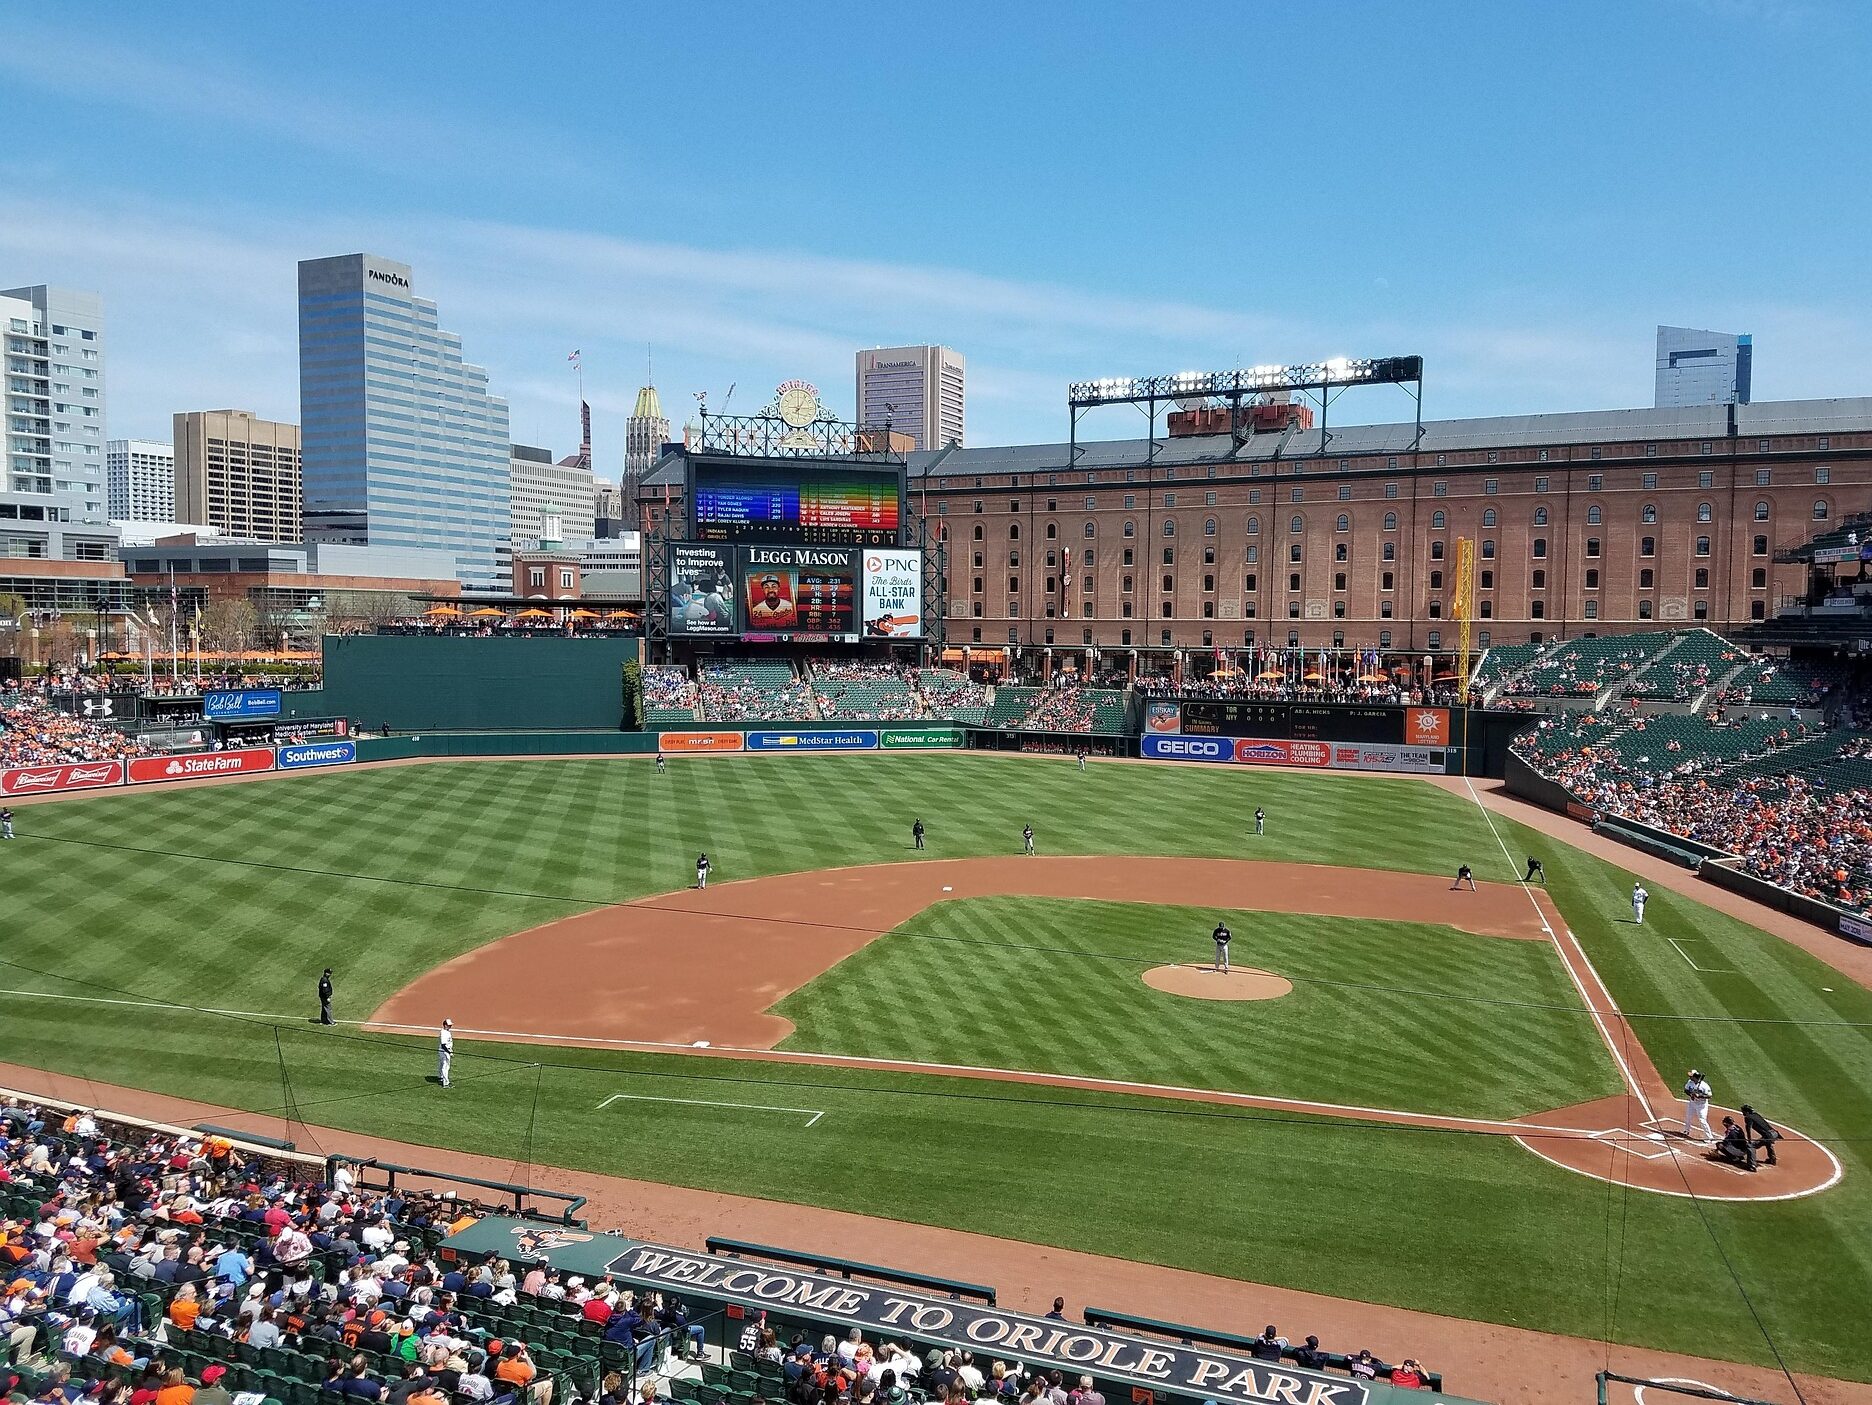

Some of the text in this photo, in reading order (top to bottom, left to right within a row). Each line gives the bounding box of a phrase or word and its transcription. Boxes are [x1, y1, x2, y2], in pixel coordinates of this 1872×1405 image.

[855, 534, 894, 544] 2 0 1
[676, 547, 716, 559] Investing
[749, 548, 849, 566] LEGG MASON
[676, 558, 724, 568] to Improve
[884, 558, 919, 572] PNC
[677, 567, 700, 576] Lives
[871, 575, 913, 586] The Birds
[869, 586, 915, 598] ALL-STAR
[879, 598, 905, 610] BANK
[753, 610, 763, 618] 24
[834, 634, 840, 642] 0
[207, 693, 243, 711] Bob Bell
[1152, 706, 1175, 714] ESSKAY
[274, 724, 302, 732] University
[309, 722, 334, 730] Maryland
[1184, 724, 1220, 733] SUMMARY
[798, 736, 863, 745] MedStar Health
[894, 735, 924, 743] National
[1157, 740, 1219, 756] GEICO
[1290, 743, 1321, 752] HEATING
[286, 748, 341, 763] Southwest
[1242, 750, 1287, 760] HORIZON
[1290, 750, 1326, 759] PLUMBING
[1290, 756, 1321, 765] COOLING
[18, 775, 56, 785] Budweiser
[72, 771, 107, 780] Budweiser
[629, 1250, 1350, 1405] WELCOME TO ORIOLE PARK
[343, 1332, 358, 1350] 13
[739, 1334, 757, 1351] 55
